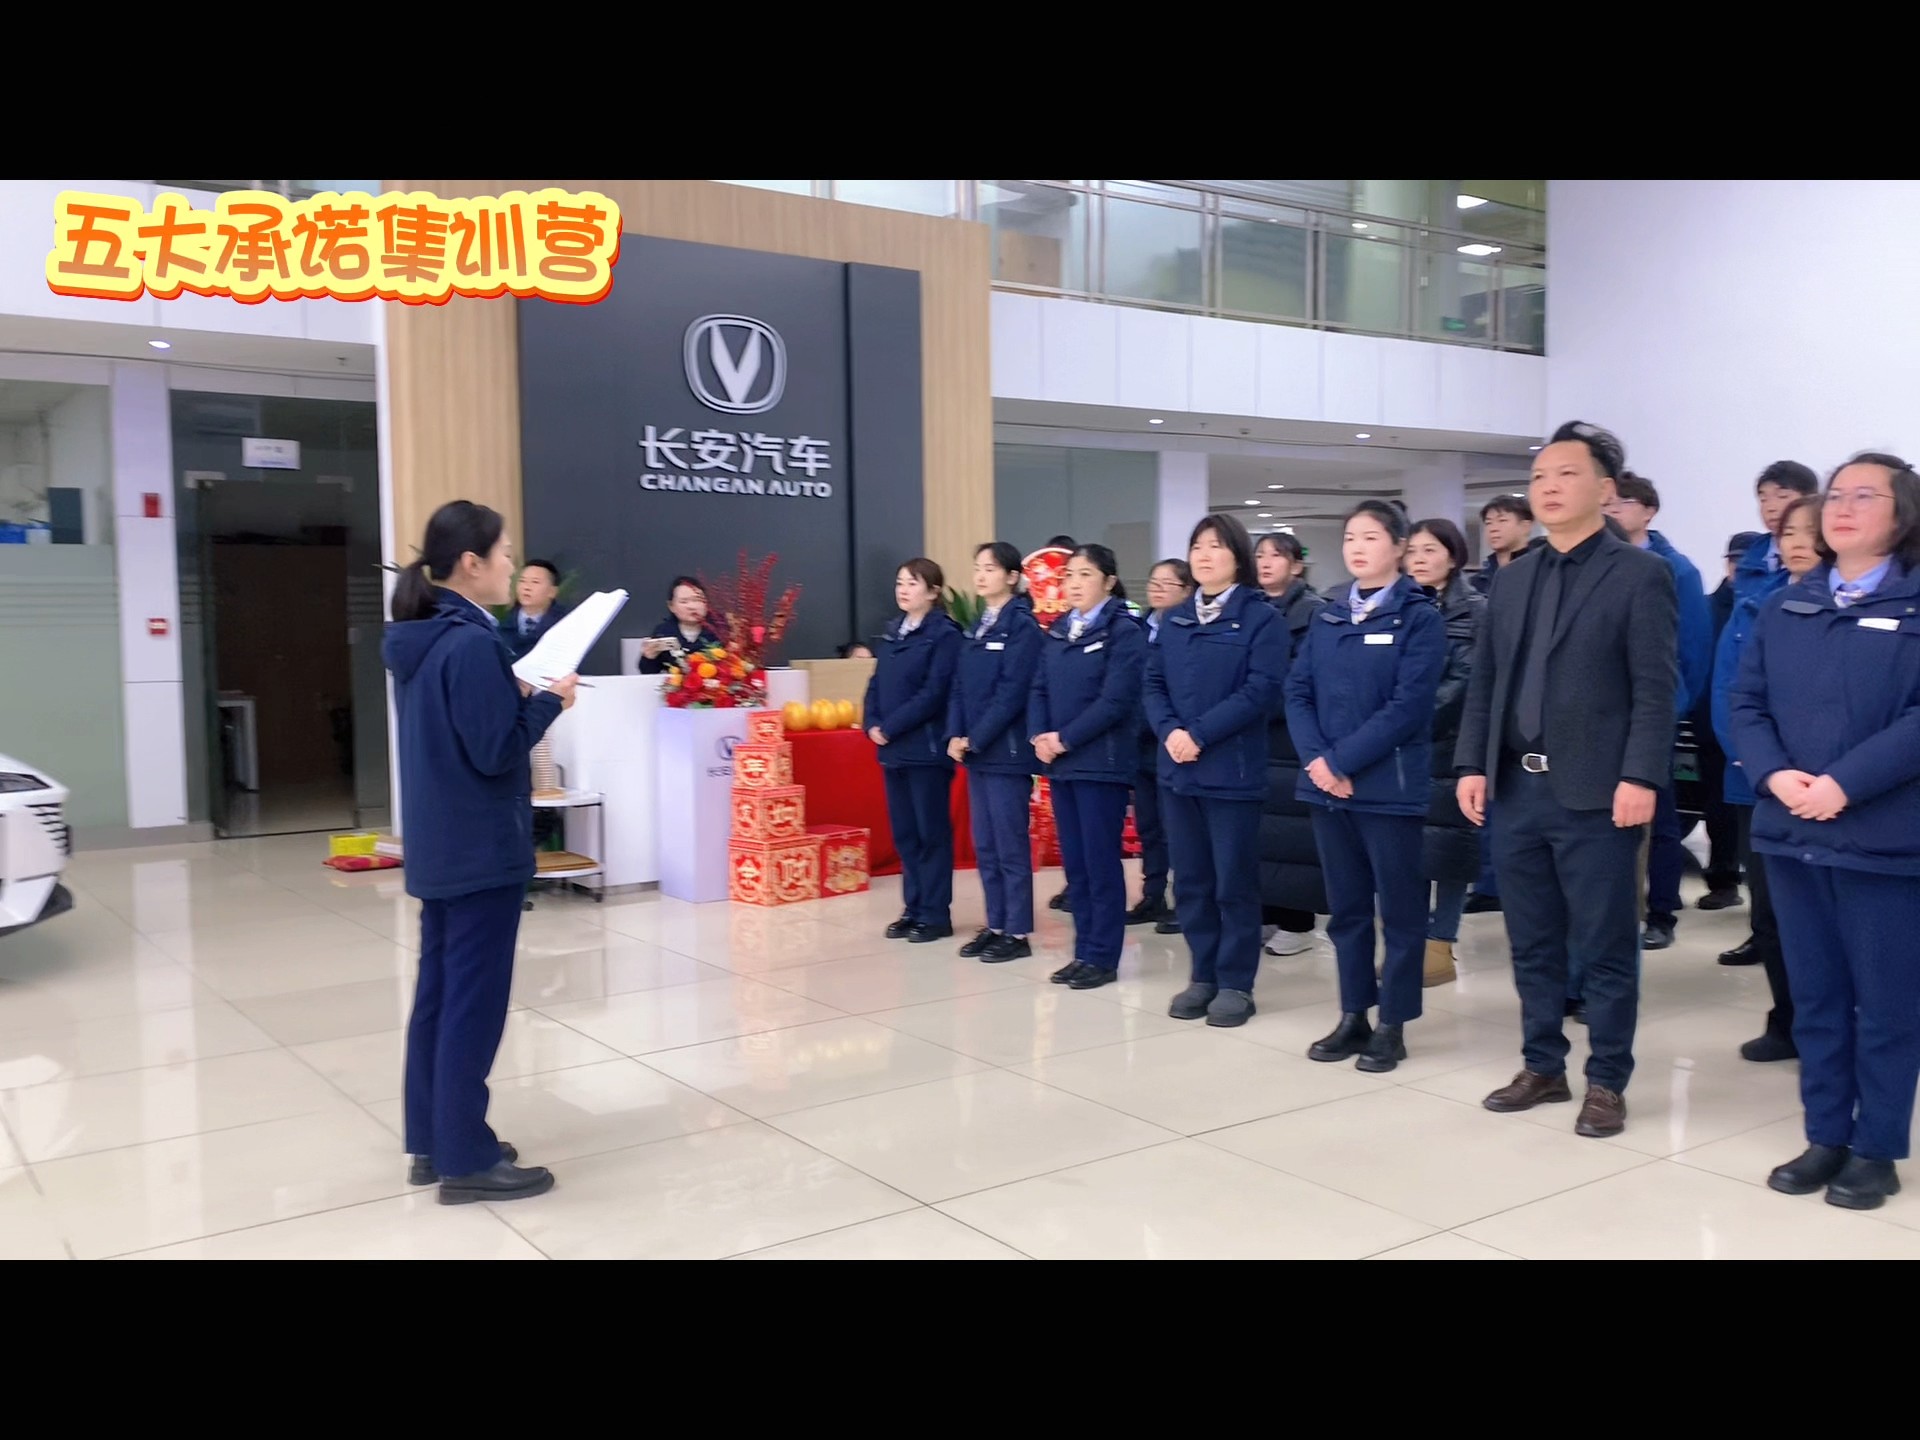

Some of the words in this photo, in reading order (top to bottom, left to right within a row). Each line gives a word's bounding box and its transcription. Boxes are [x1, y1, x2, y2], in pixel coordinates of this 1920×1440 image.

[638, 424, 832, 478] 长安汽车
[639, 473, 765, 495] CHANGAN
[767, 480, 833, 498] AUTO
